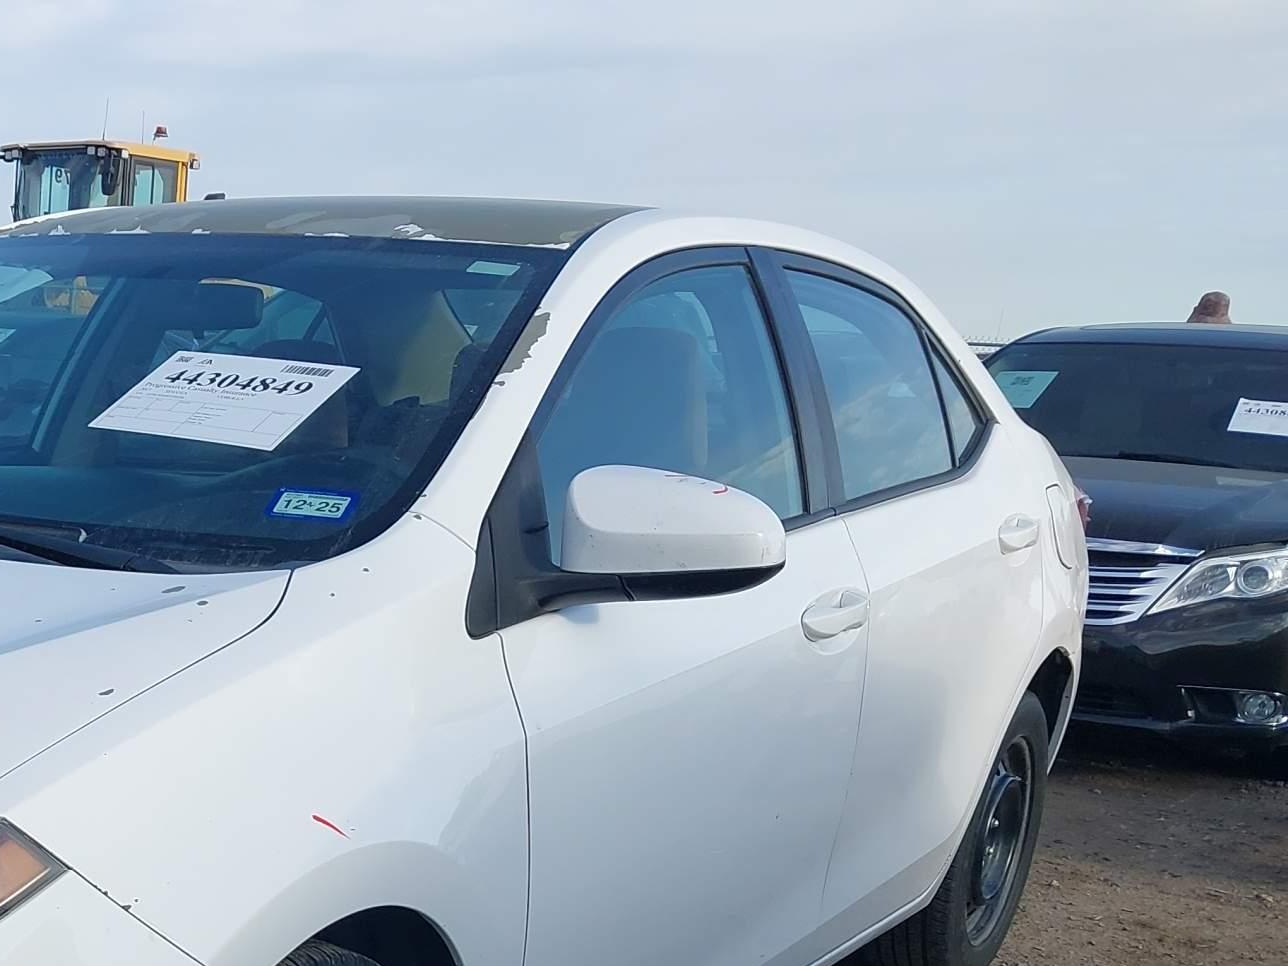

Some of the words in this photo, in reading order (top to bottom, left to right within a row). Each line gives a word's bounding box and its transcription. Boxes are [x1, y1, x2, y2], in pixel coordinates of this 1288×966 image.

[164, 369, 314, 396] 44304849
[1244, 407, 1288, 416] 44308
[283, 499, 307, 510] 12
[314, 501, 344, 514] 25
